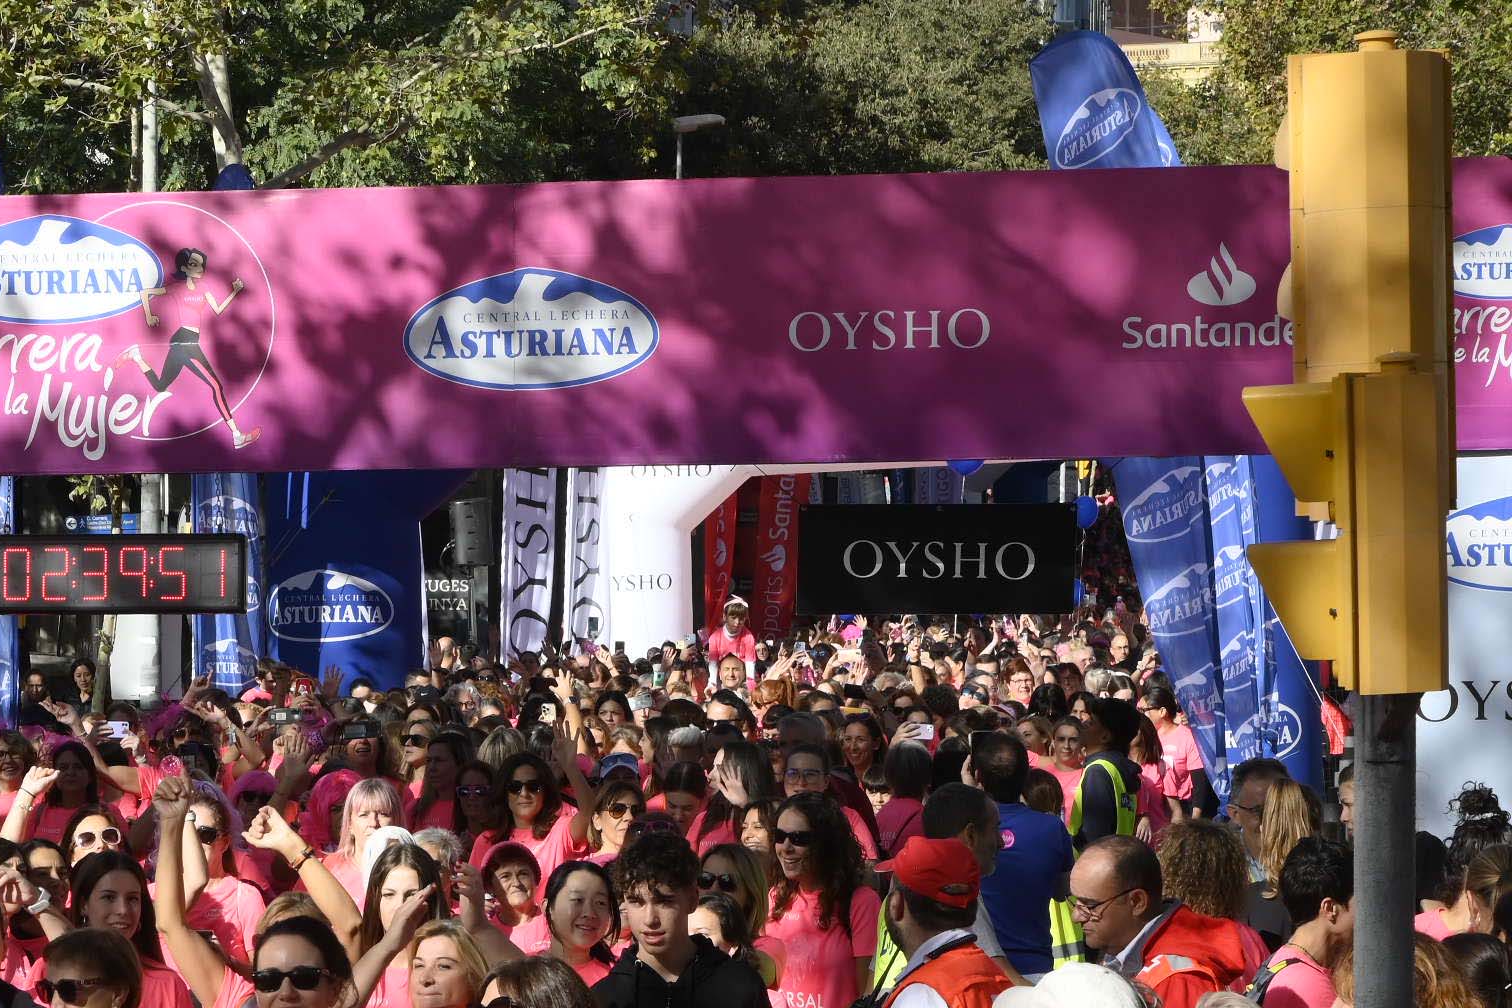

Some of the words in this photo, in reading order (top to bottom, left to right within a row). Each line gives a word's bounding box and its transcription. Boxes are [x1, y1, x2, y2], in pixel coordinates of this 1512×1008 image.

[424, 314, 640, 360] ASTURIANA
[463, 312, 541, 323] CENTRAL
[549, 310, 630, 321] LECHERA
[788, 308, 991, 352] OYSHO
[1122, 316, 1294, 349] Santande
[1471, 335, 1490, 363] la
[4, 377, 29, 416] la
[23, 368, 173, 461] Mujer
[769, 474, 795, 541] Santa
[510, 467, 550, 656] OYSH
[843, 539, 1036, 580] OYSHO
[611, 573, 673, 593] YSHO
[273, 603, 385, 626] ASTURIANA
